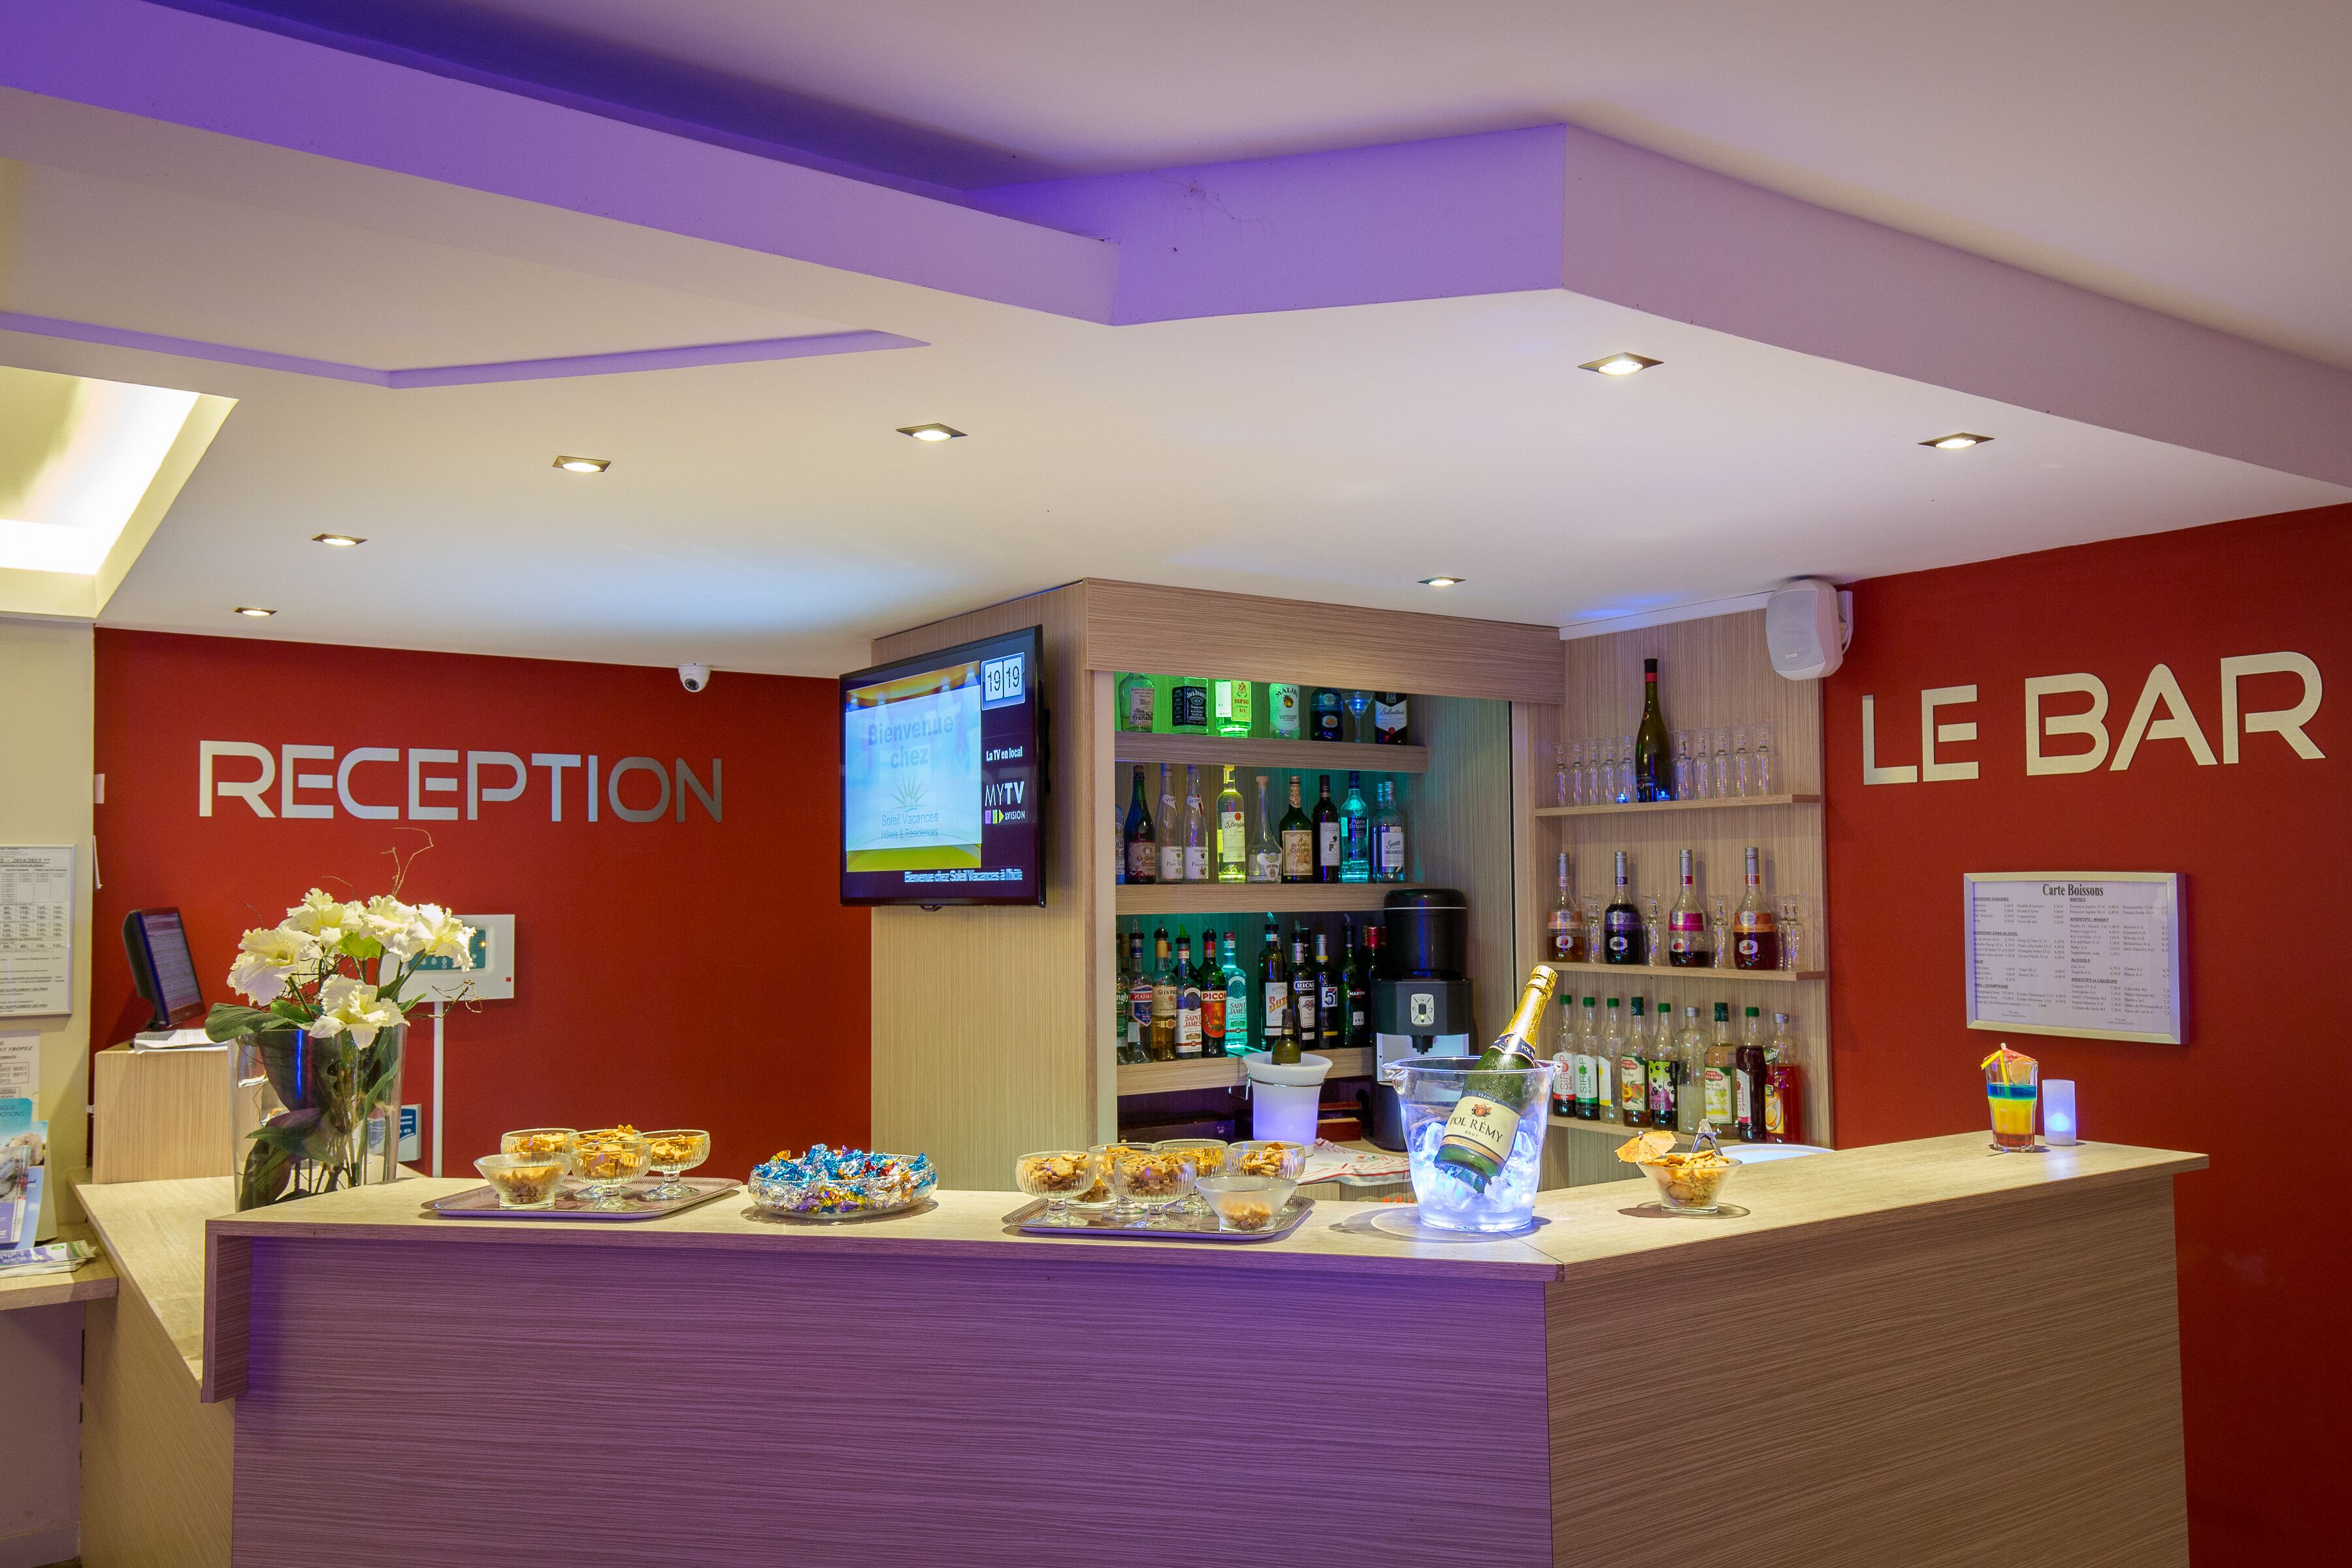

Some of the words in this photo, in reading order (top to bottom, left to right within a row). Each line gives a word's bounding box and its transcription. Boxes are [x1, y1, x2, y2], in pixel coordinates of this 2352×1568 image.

[987, 670, 1001, 693] 19
[1006, 665, 1021, 689] 19
[1862, 685, 1979, 785] LE
[2025, 651, 2326, 776] BAR
[868, 714, 954, 745] Bienvenue
[890, 745, 929, 769] chez
[987, 751, 993, 761] La
[993, 749, 1001, 760] TV
[1001, 750, 1008, 760] en
[1009, 746, 1022, 759] local
[199, 740, 722, 823] RECEPTION
[881, 814, 900, 826] Soleil
[902, 812, 939, 825] Vacances
[2042, 883, 2065, 896] Carte
[2068, 883, 2104, 896] Boissons
[1325, 988, 1337, 1005] 51
[1521, 1045, 1531, 1054] POL
[1478, 1093, 1496, 1102] FRANCE
[1450, 1117, 1466, 1126] POL
[1470, 1119, 1503, 1143] RÉMY
